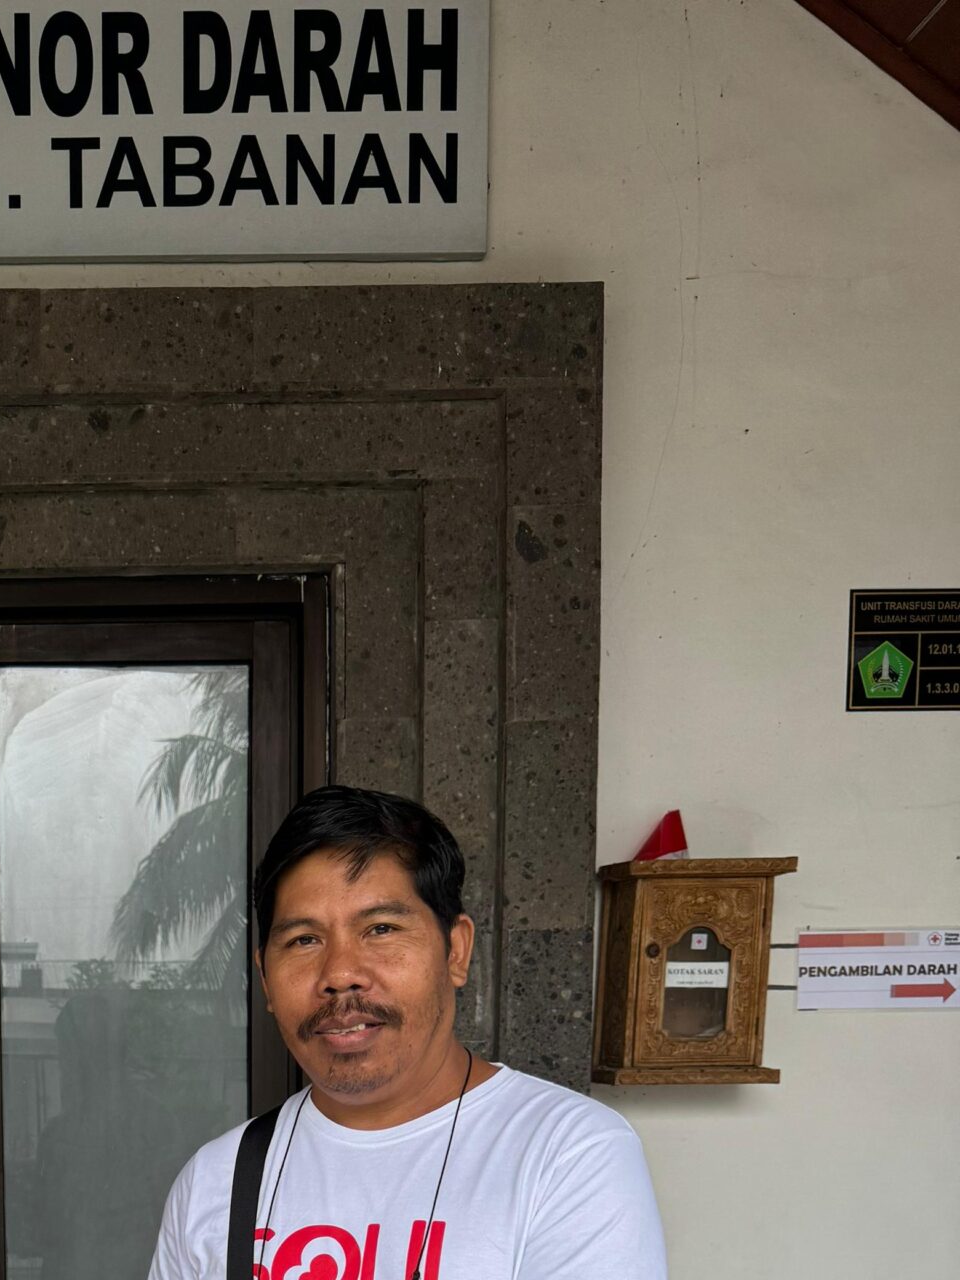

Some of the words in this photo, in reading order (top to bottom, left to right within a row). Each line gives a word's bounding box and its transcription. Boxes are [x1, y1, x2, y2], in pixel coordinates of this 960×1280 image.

[183, 8, 458, 114] DARAH
[51, 132, 458, 209] TABANAN
[861, 601, 882, 611] UNIT
[884, 601, 936, 611] TRANSFUSI
[874, 614, 907, 624] RUMAH
[909, 614, 936, 623] SAKIT
[798, 964, 903, 978] PENGAMBILAN
[907, 963, 958, 976] DARAH
